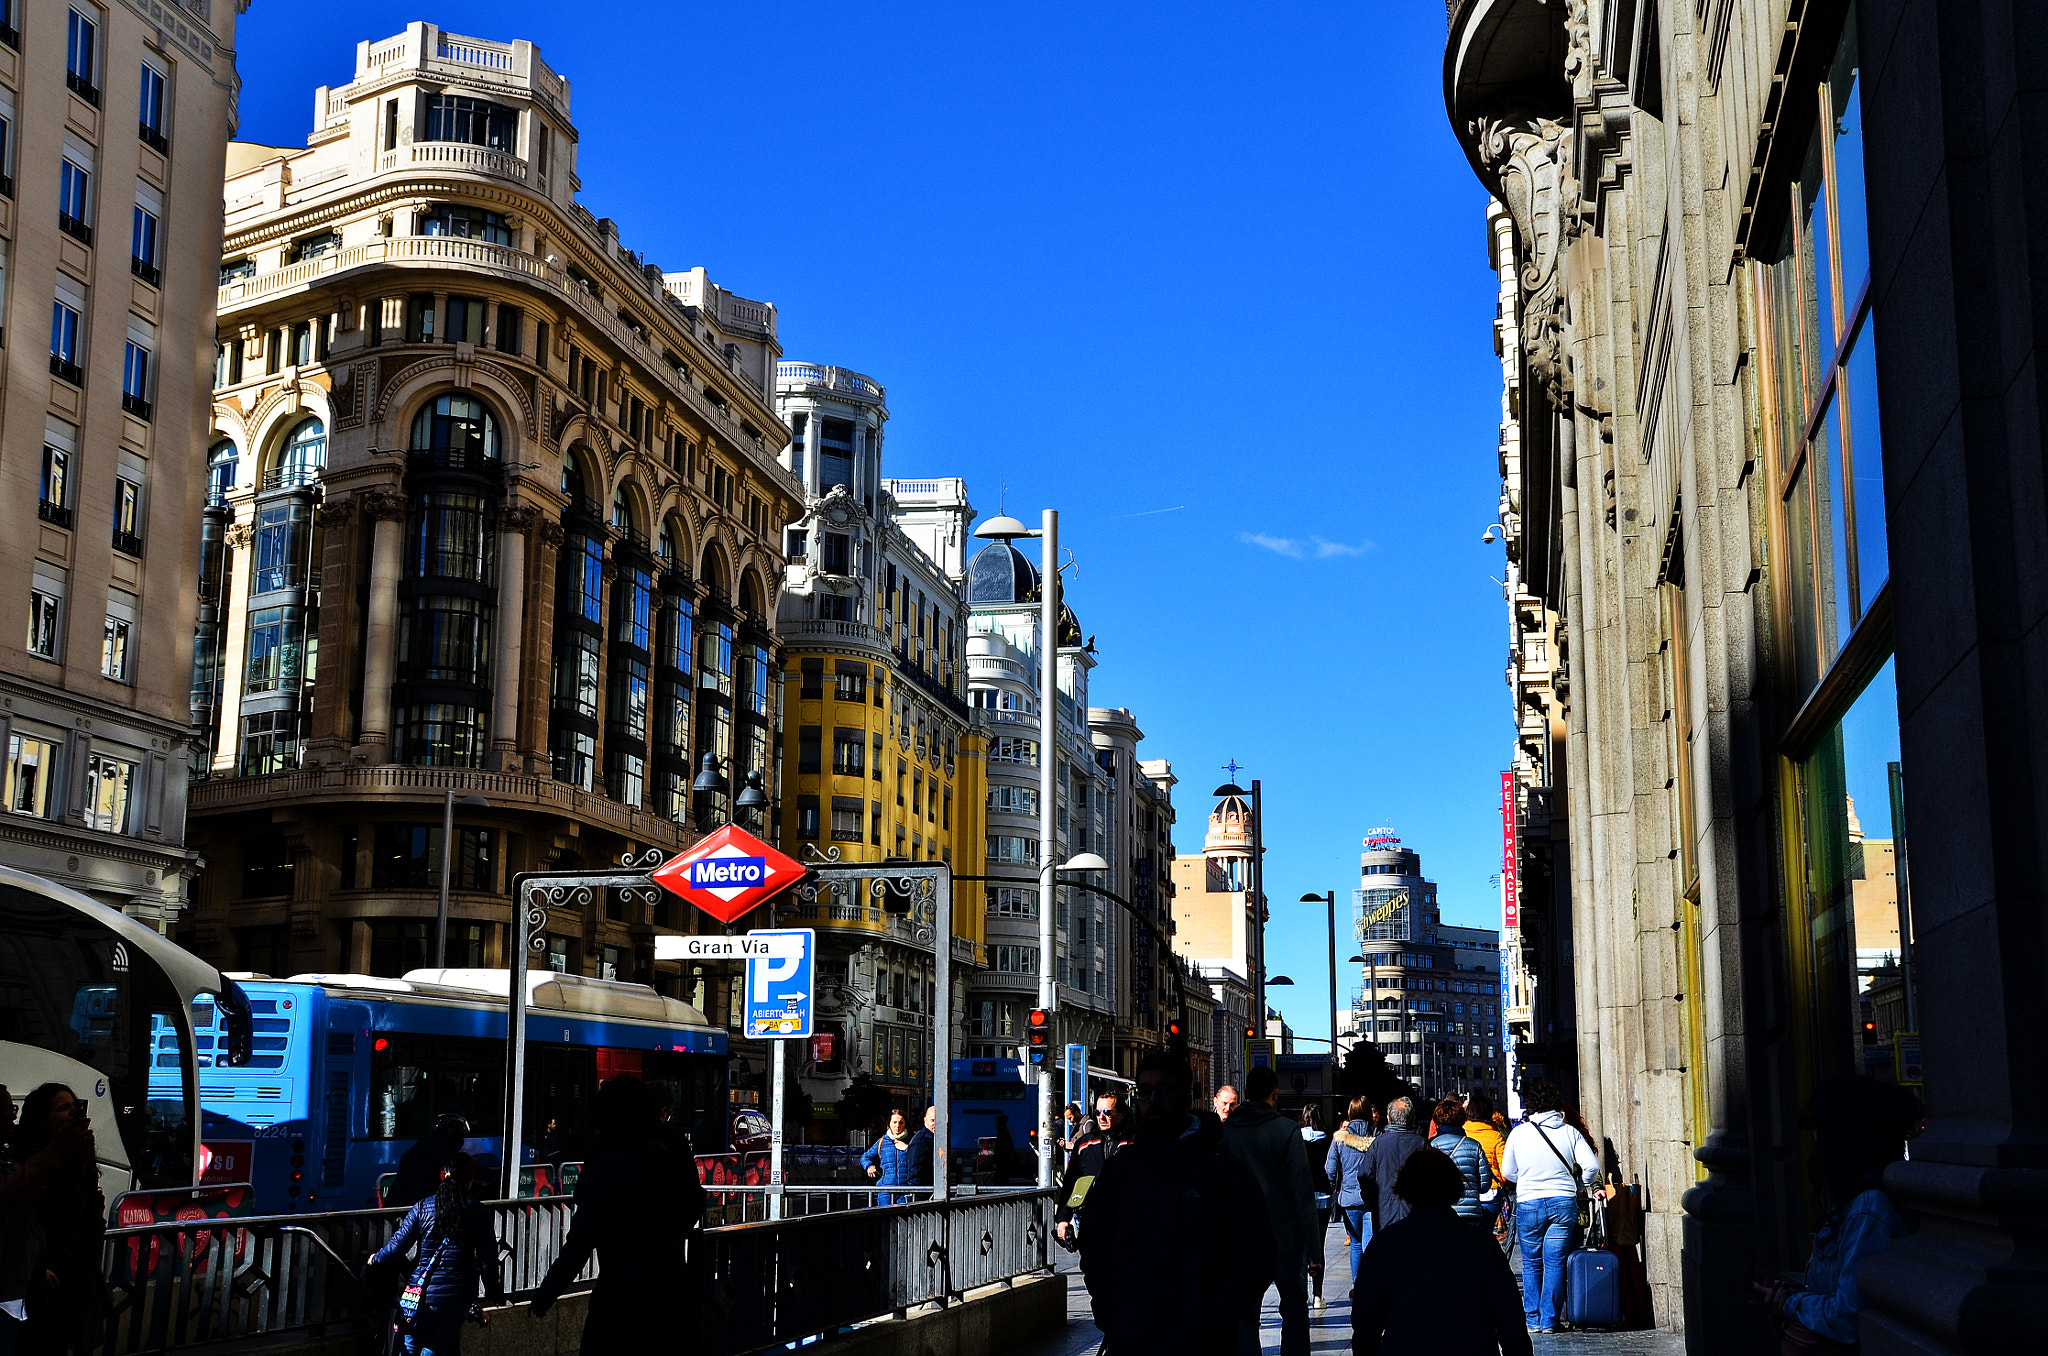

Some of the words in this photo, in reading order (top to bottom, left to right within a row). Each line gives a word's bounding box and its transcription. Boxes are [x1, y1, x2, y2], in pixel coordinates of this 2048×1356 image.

[1504, 781, 1513, 832] PETIT
[696, 862, 760, 882] Metro
[1506, 838, 1515, 902] PALACE
[1355, 890, 1409, 938] Schweppes
[689, 940, 733, 954] Gran
[741, 939, 769, 954] Vía
[754, 958, 800, 1003] P
[1139, 935, 1149, 1012] REGENTE
[1501, 950, 1509, 985] HOTEL
[752, 1009, 784, 1018] ABIERTO
[799, 1009, 805, 1018] H
[253, 1126, 288, 1138] 8224
[123, 1209, 150, 1224] MADRID
